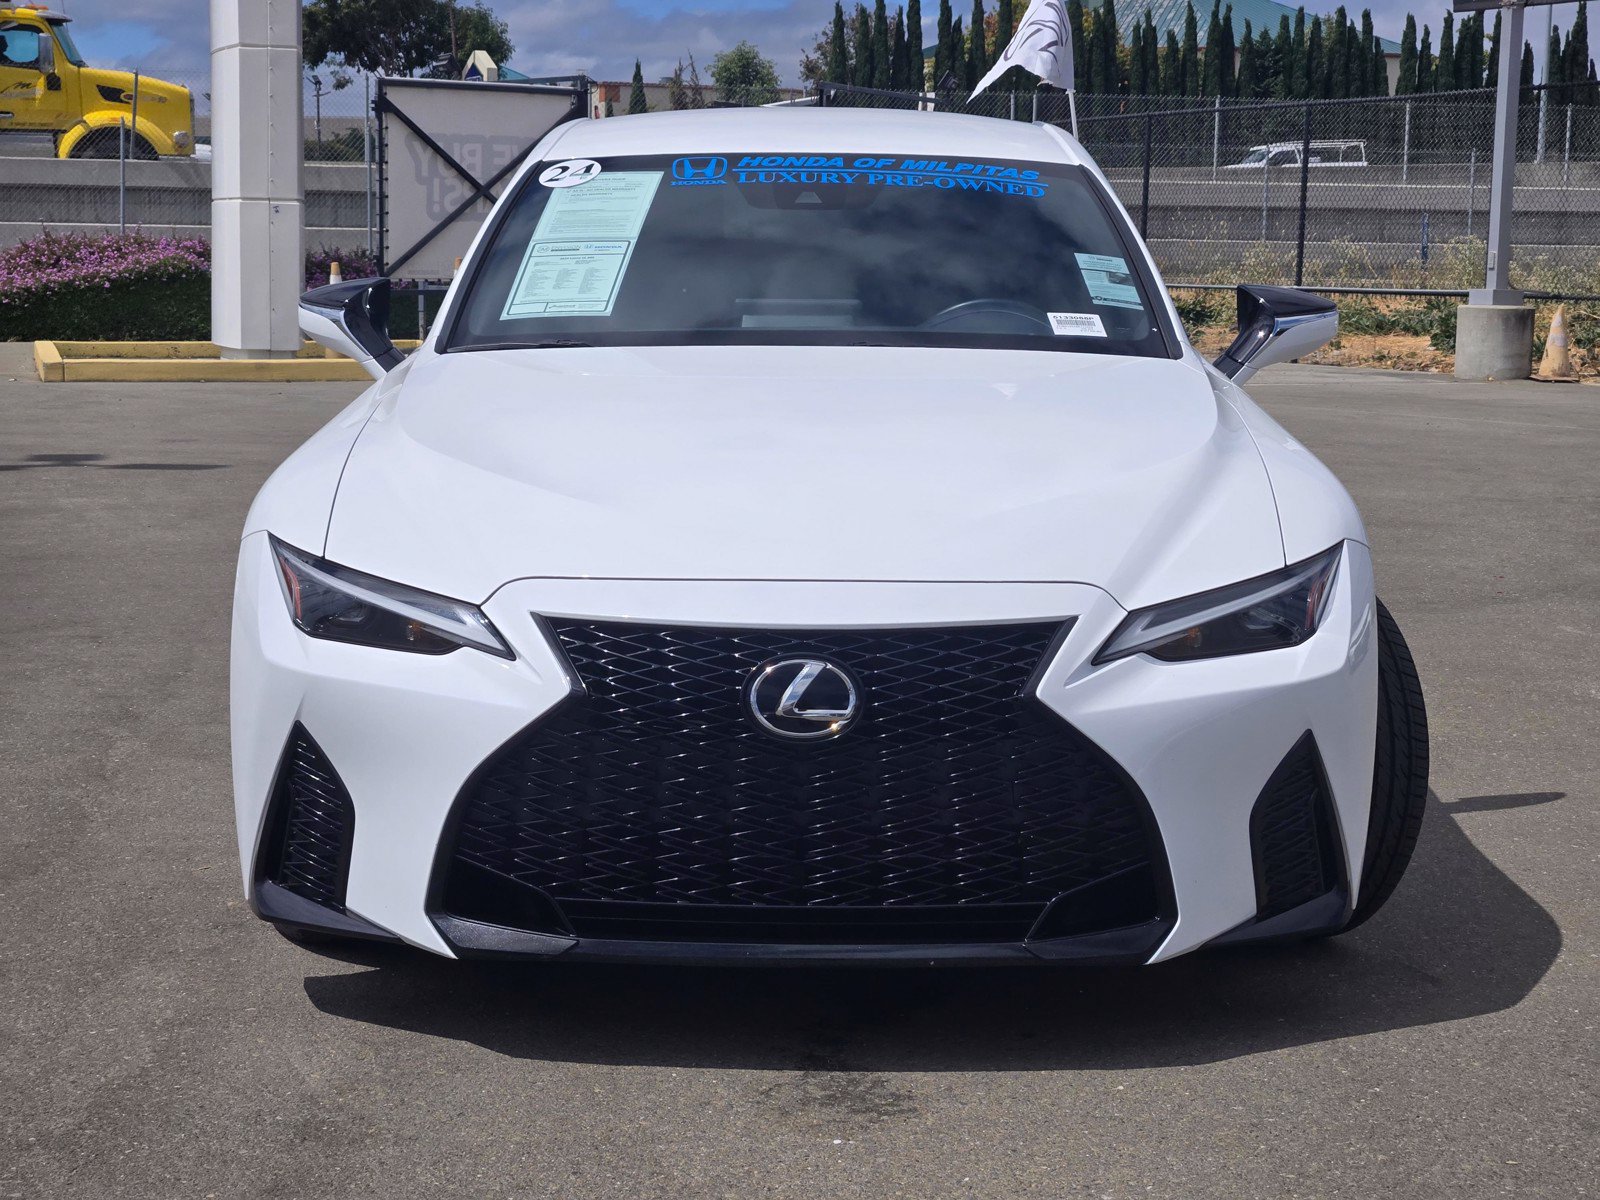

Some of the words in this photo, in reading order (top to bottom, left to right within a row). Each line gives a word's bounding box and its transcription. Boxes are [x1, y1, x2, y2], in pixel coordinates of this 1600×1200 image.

[543, 163, 595, 183] 24
[738, 156, 844, 168] HONDA
[853, 157, 896, 169] OF
[900, 159, 1040, 181] MILPITAS
[737, 171, 859, 185] LUXURY
[868, 173, 1046, 198] PRE-OWNED
